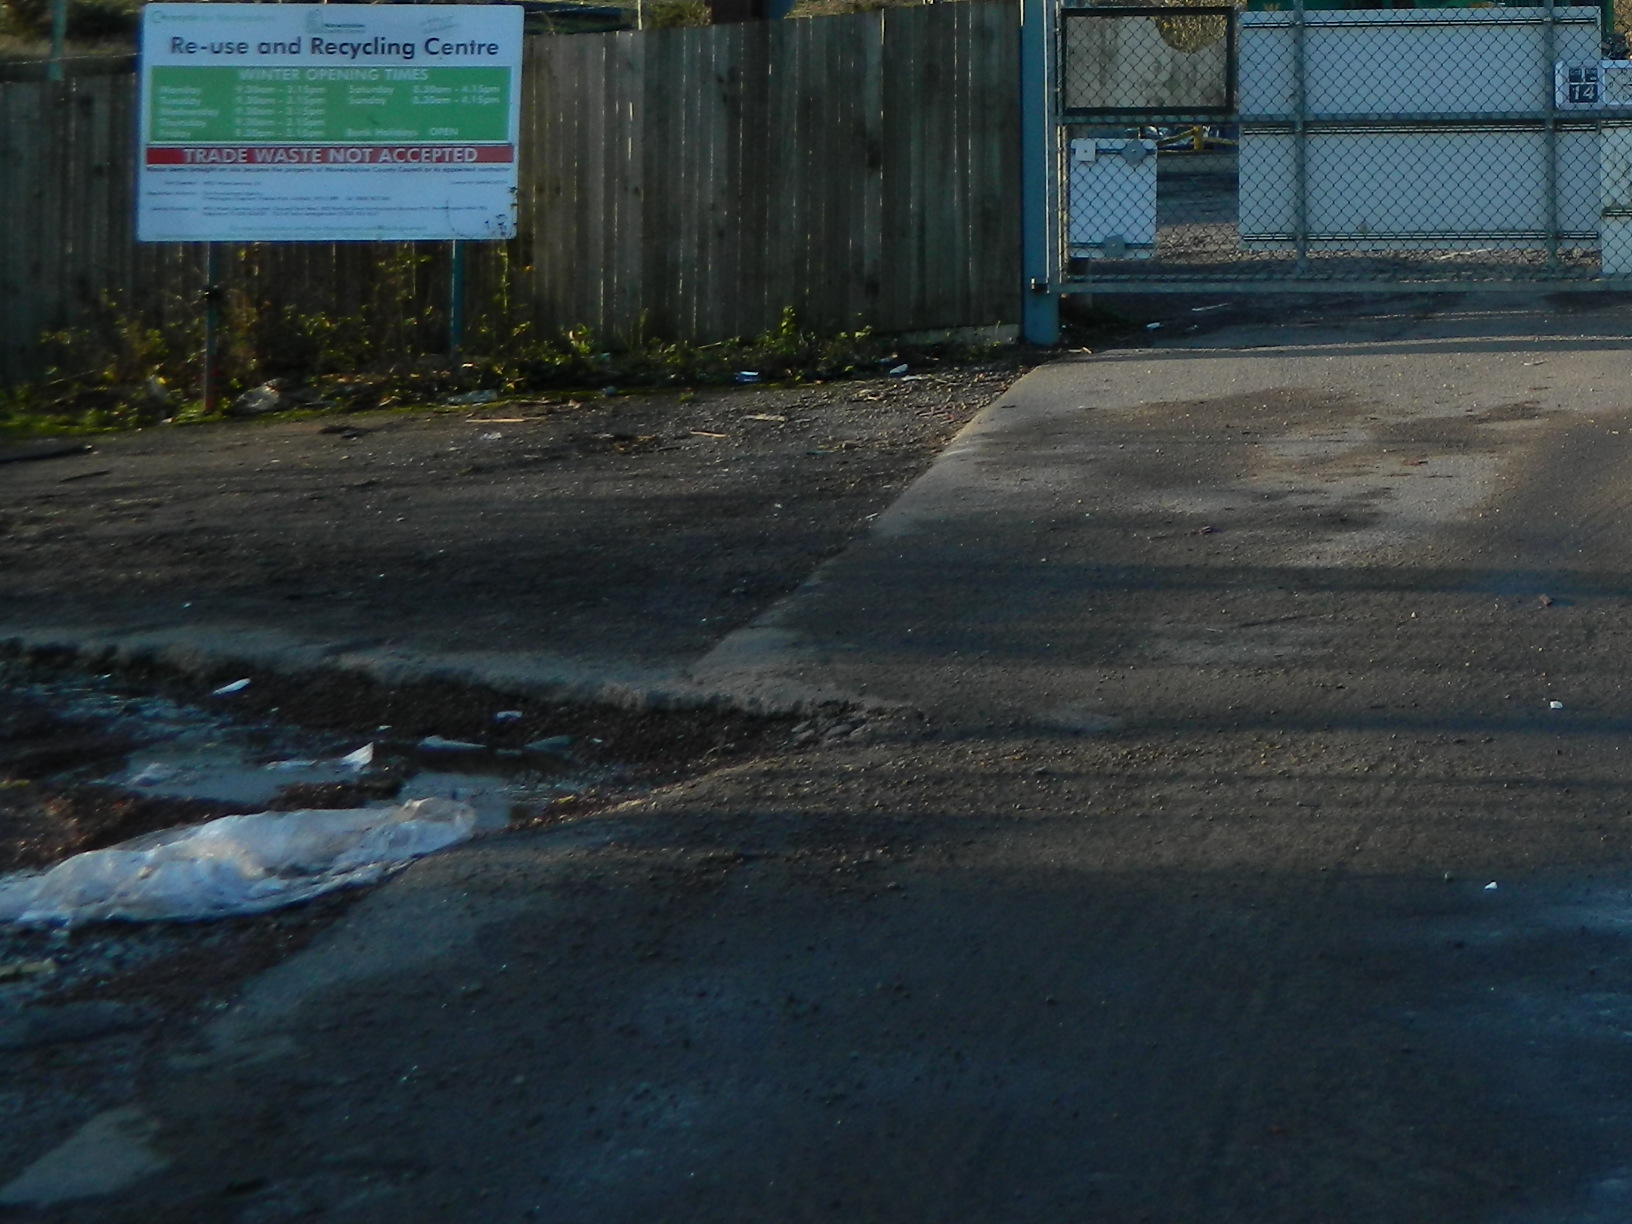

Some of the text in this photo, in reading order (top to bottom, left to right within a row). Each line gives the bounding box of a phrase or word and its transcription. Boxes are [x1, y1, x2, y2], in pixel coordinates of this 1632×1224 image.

[170, 35, 499, 60] Re-use and Recycling Centre
[239, 68, 429, 81] WINTER OPENING TIMES
[1571, 85, 1595, 100] 14
[429, 127, 459, 136] OPEN
[184, 146, 479, 163] TRADE WASTE NOT ACCEPTED
